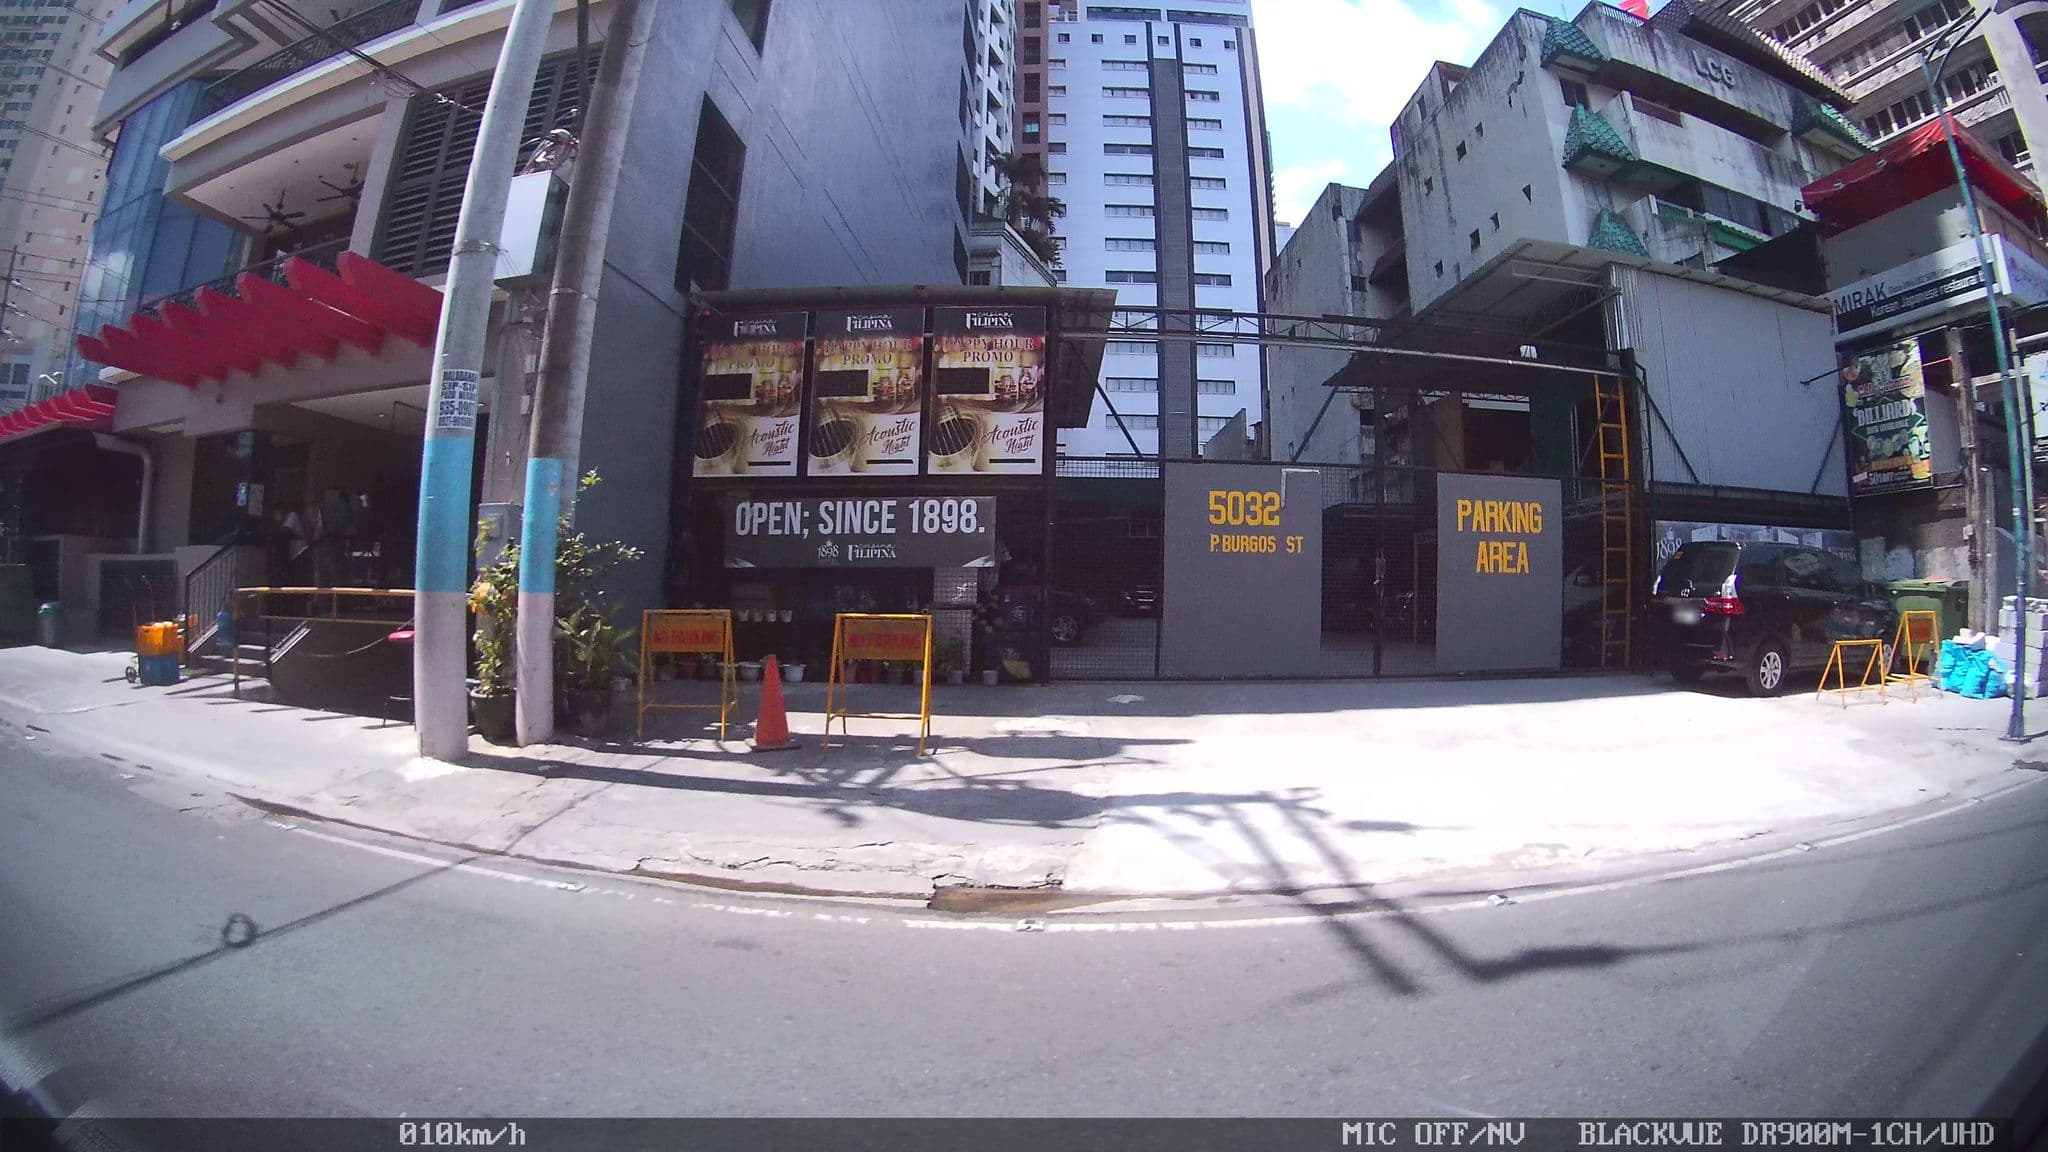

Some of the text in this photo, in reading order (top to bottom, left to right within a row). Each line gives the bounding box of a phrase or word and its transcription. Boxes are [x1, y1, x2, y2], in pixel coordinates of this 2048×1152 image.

[1834, 282, 1888, 316] MIRAK
[1870, 300, 1898, 318] Korean
[846, 316, 893, 332] FILIPINA
[966, 313, 1013, 330] FILIPINA
[994, 338, 1034, 350] HOUR
[843, 354, 892, 365] PROMO
[963, 351, 1013, 362] PROMO
[747, 420, 794, 446] Acoustic
[865, 418, 916, 444] Acoustic
[981, 417, 1039, 444] Acoustic
[1005, 434, 1034, 454] Night
[1209, 491, 1280, 526] 5032
[1457, 499, 1543, 534] PARKING
[735, 499, 985, 539] OPEN; SINCE 1898.
[816, 544, 839, 559] 1898
[848, 544, 896, 561] FILIPINA
[1476, 541, 1530, 574] AREA
